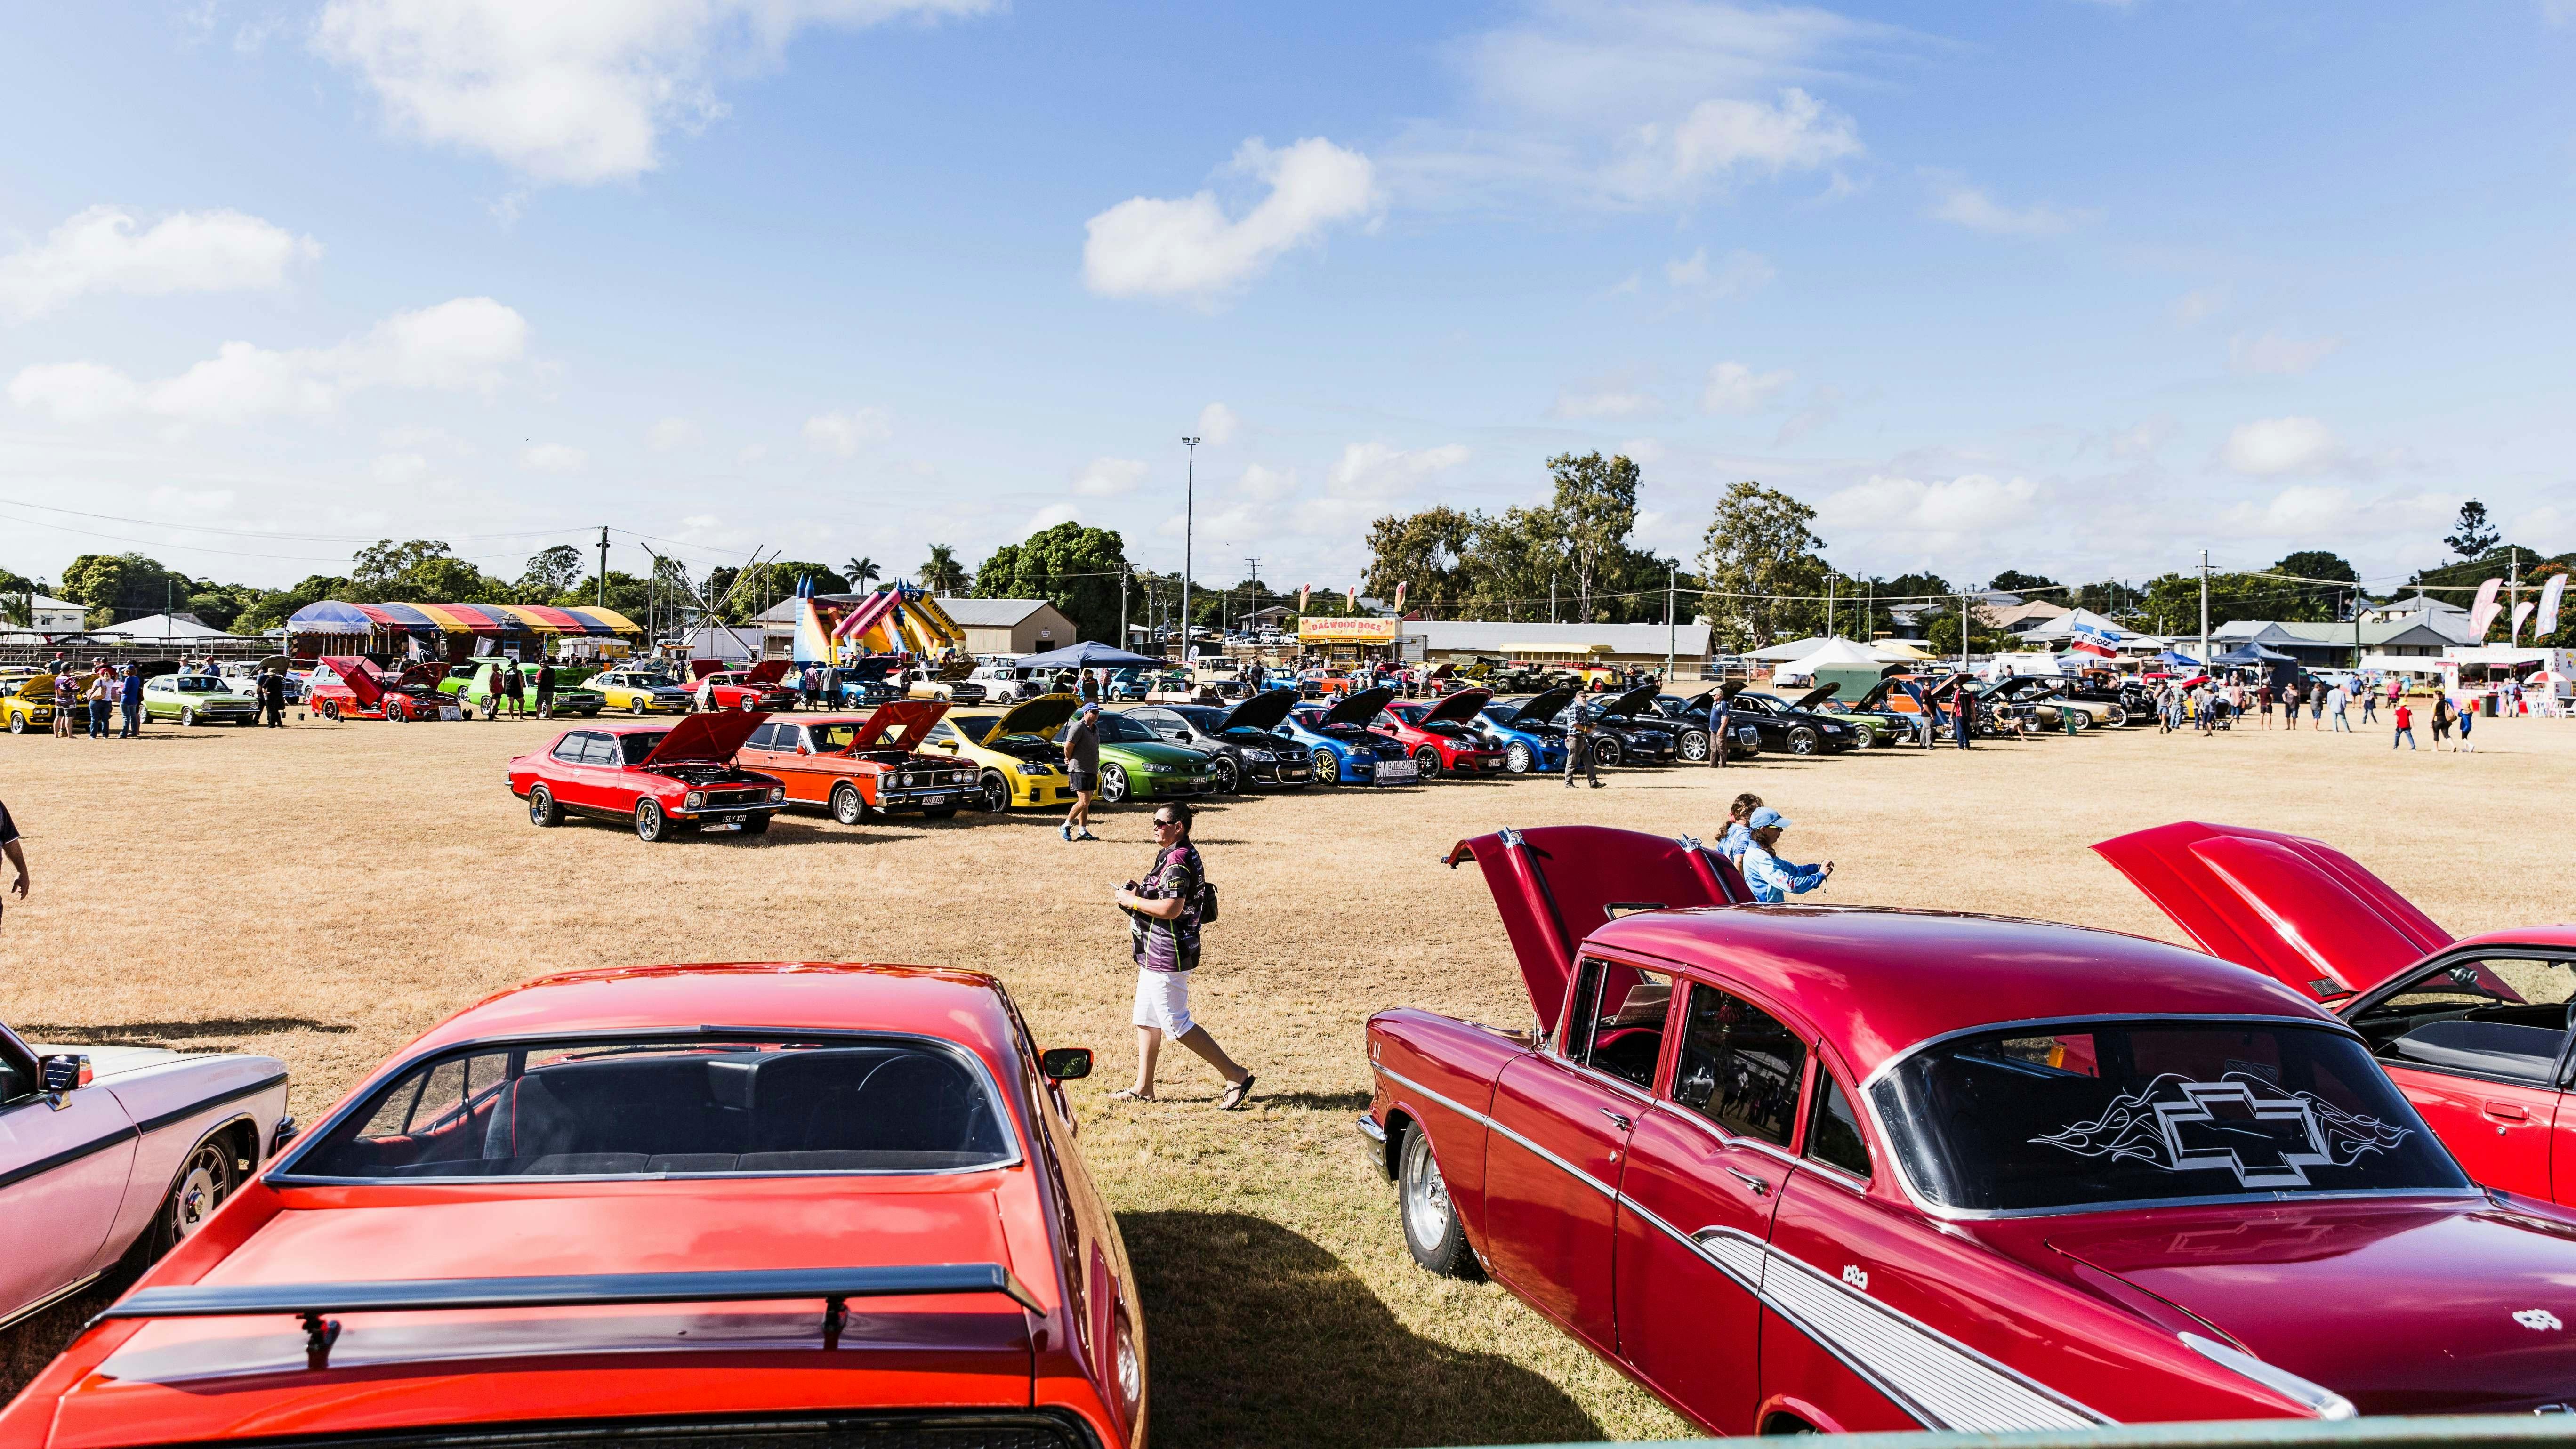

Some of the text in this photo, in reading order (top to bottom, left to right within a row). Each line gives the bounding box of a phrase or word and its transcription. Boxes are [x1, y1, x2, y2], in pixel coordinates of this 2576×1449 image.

[865, 600, 894, 629] ISSAC'S
[928, 600, 959, 632] FRIENDS
[1312, 621, 1381, 631] DAGWOOD DOGS
[1376, 760, 1417, 777] GM ENTHUSIASTS
